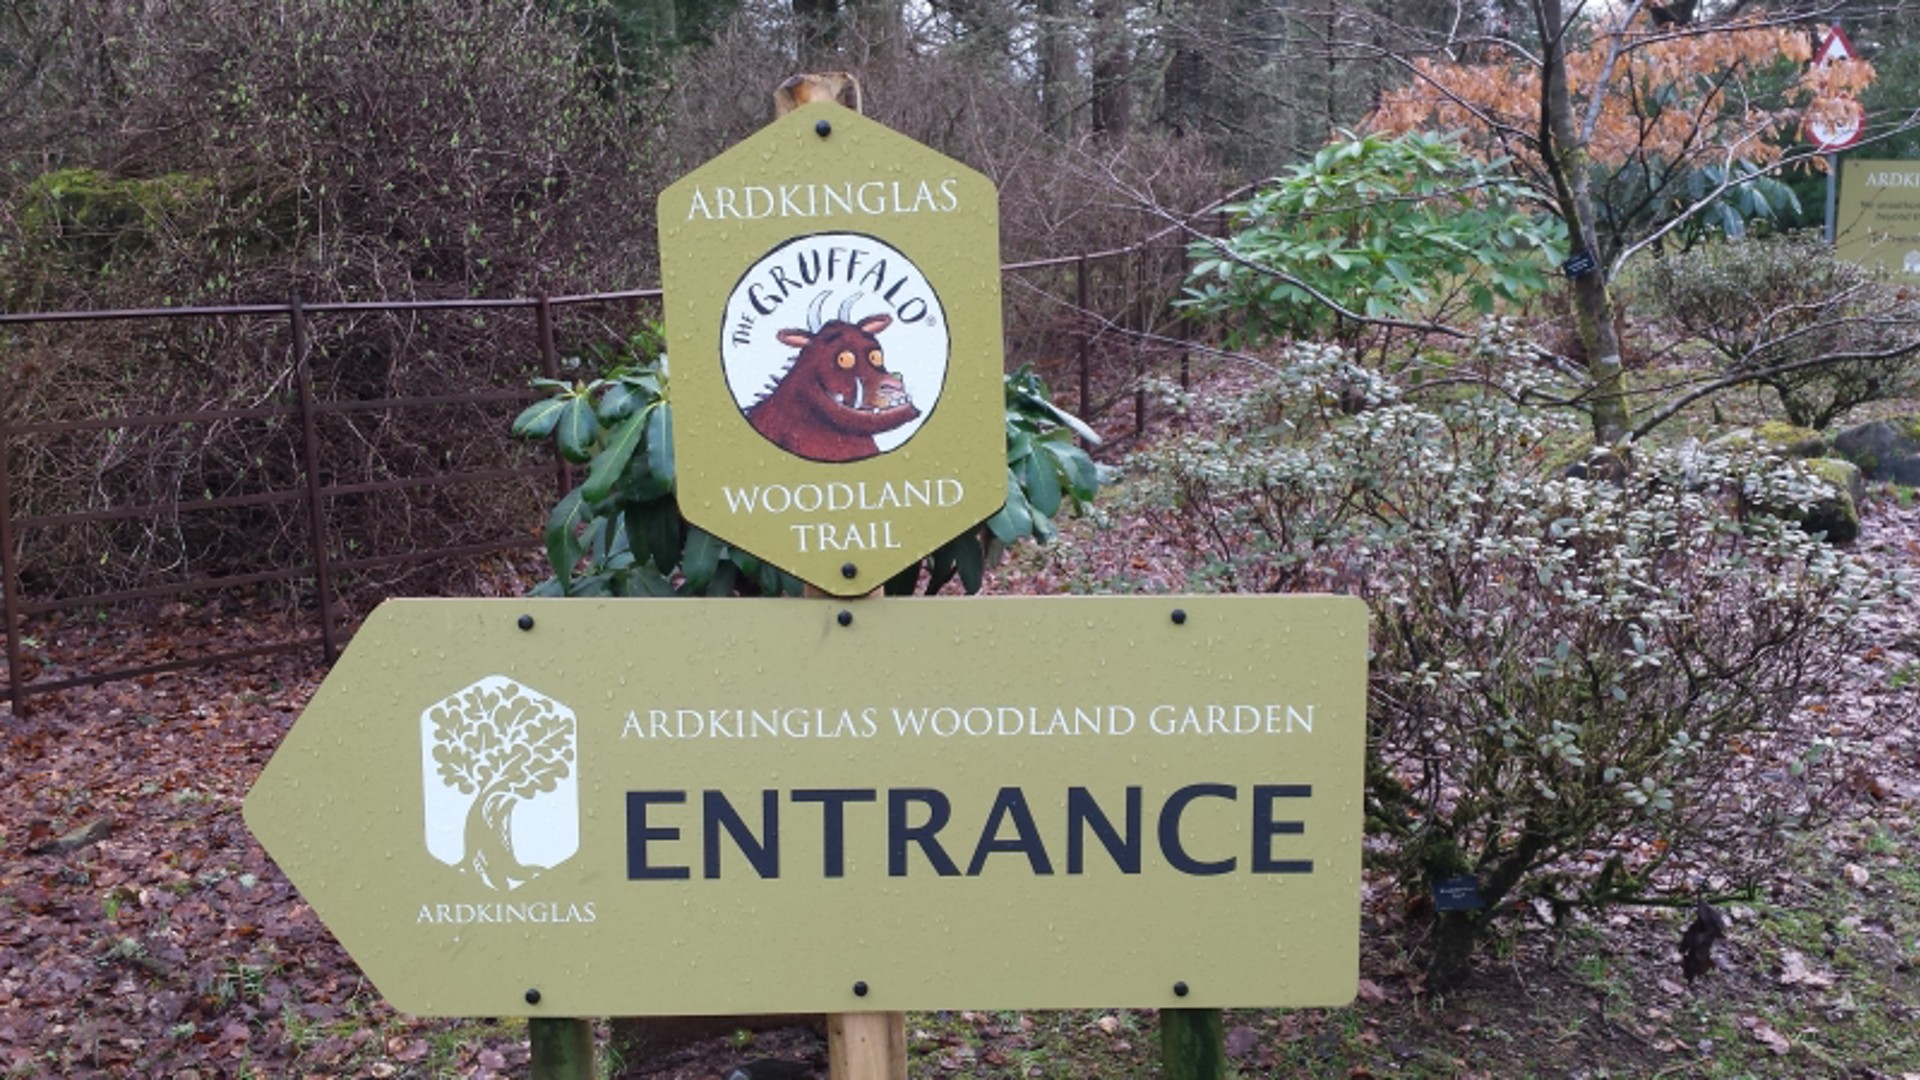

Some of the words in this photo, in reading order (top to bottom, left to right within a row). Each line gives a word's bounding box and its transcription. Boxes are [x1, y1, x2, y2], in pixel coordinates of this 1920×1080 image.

[687, 180, 959, 220] ARDKINGLAS
[732, 312, 755, 348] THE
[722, 479, 965, 515] WOODLAND
[791, 522, 902, 554] TRAIL
[621, 708, 879, 740] ARDKINGLAS
[892, 705, 1137, 738] WOODLAND
[1148, 704, 1315, 736] GARDEN
[625, 782, 1314, 881] ENTRANCE
[416, 902, 597, 924] ARDKINGLAS
